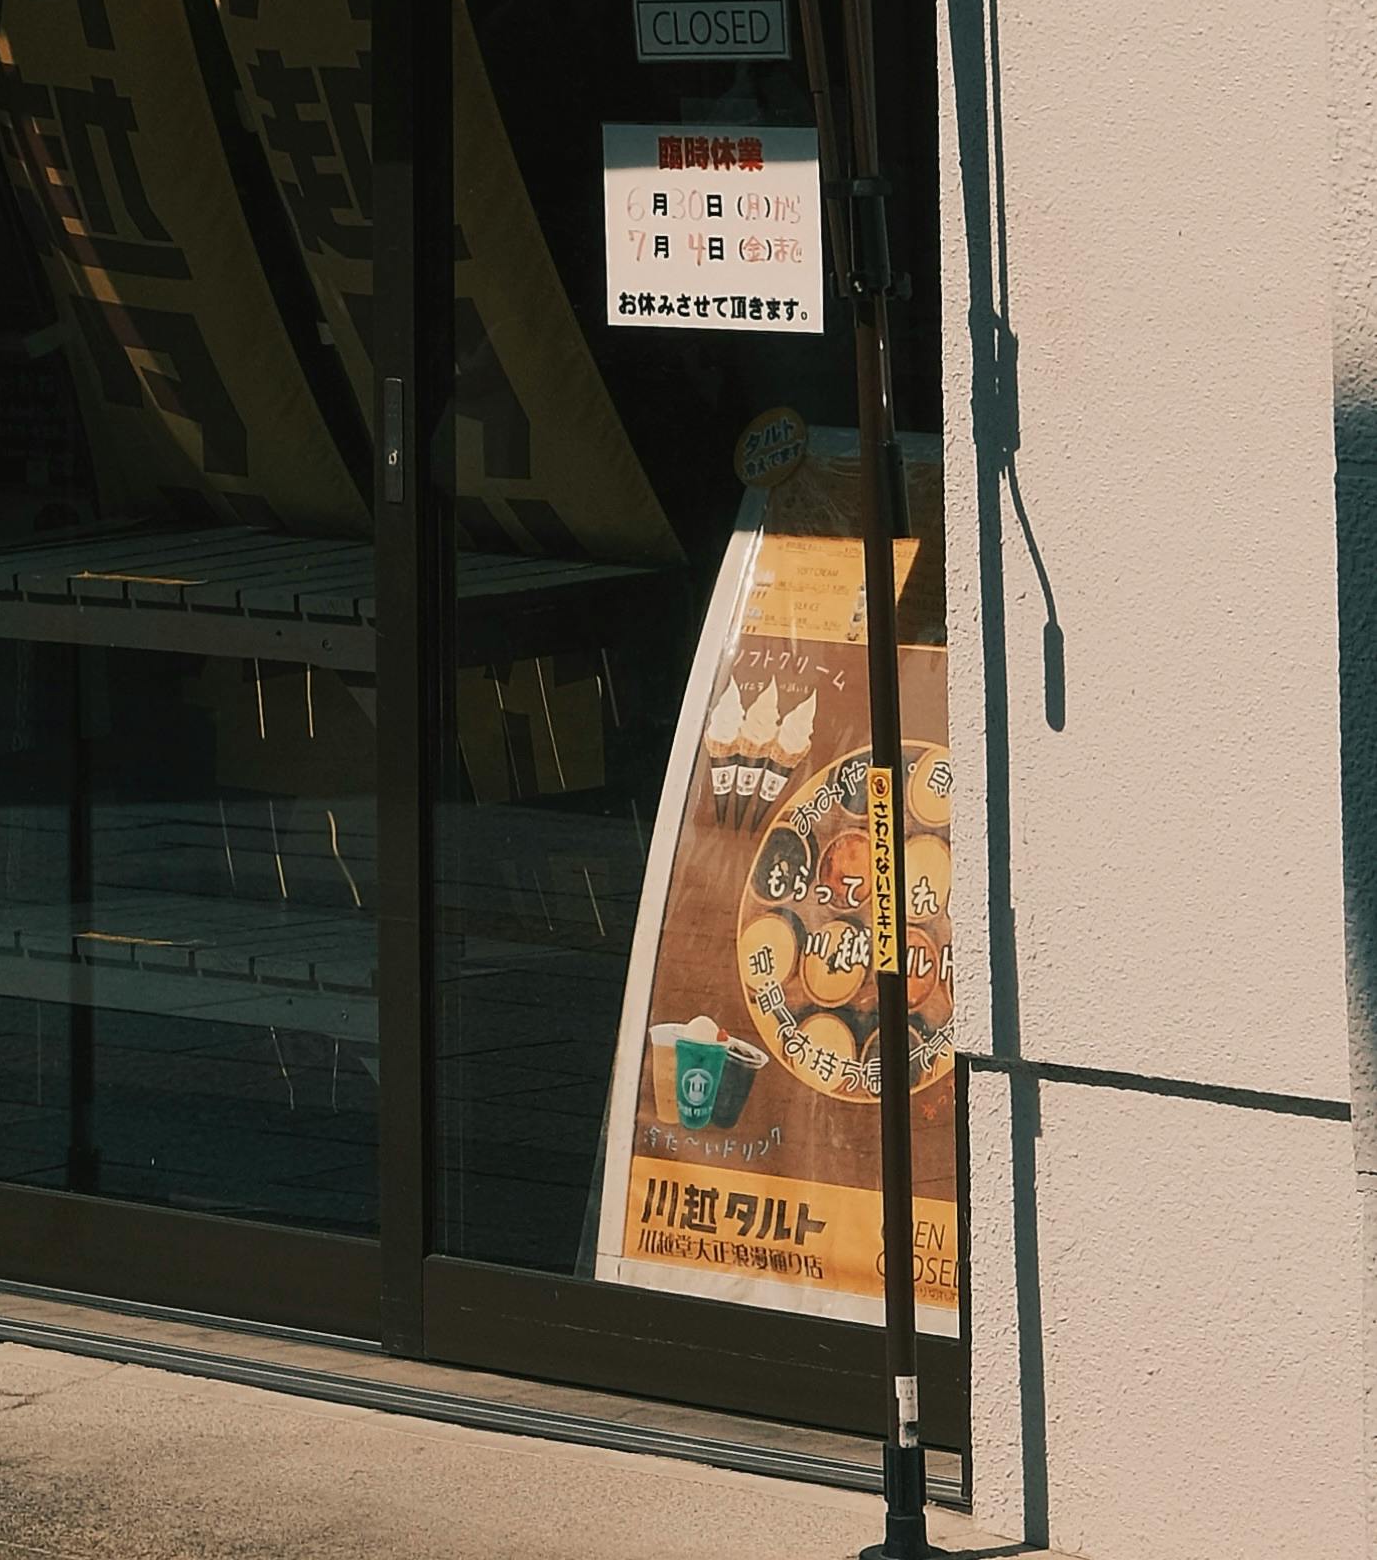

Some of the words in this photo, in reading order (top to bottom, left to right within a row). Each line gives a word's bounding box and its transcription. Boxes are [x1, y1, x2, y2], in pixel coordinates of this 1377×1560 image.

[652, 10, 770, 47] CLOSED
[658, 136, 765, 173] 臨時休業
[618, 292, 808, 321] お休みさせて頂きます。
[745, 418, 794, 455] タルト
[873, 801, 895, 968] さわらないでキケン
[641, 1178, 827, 1246] 川越タルト
[637, 1228, 824, 1280] 川越堂大正浪漫通り店
